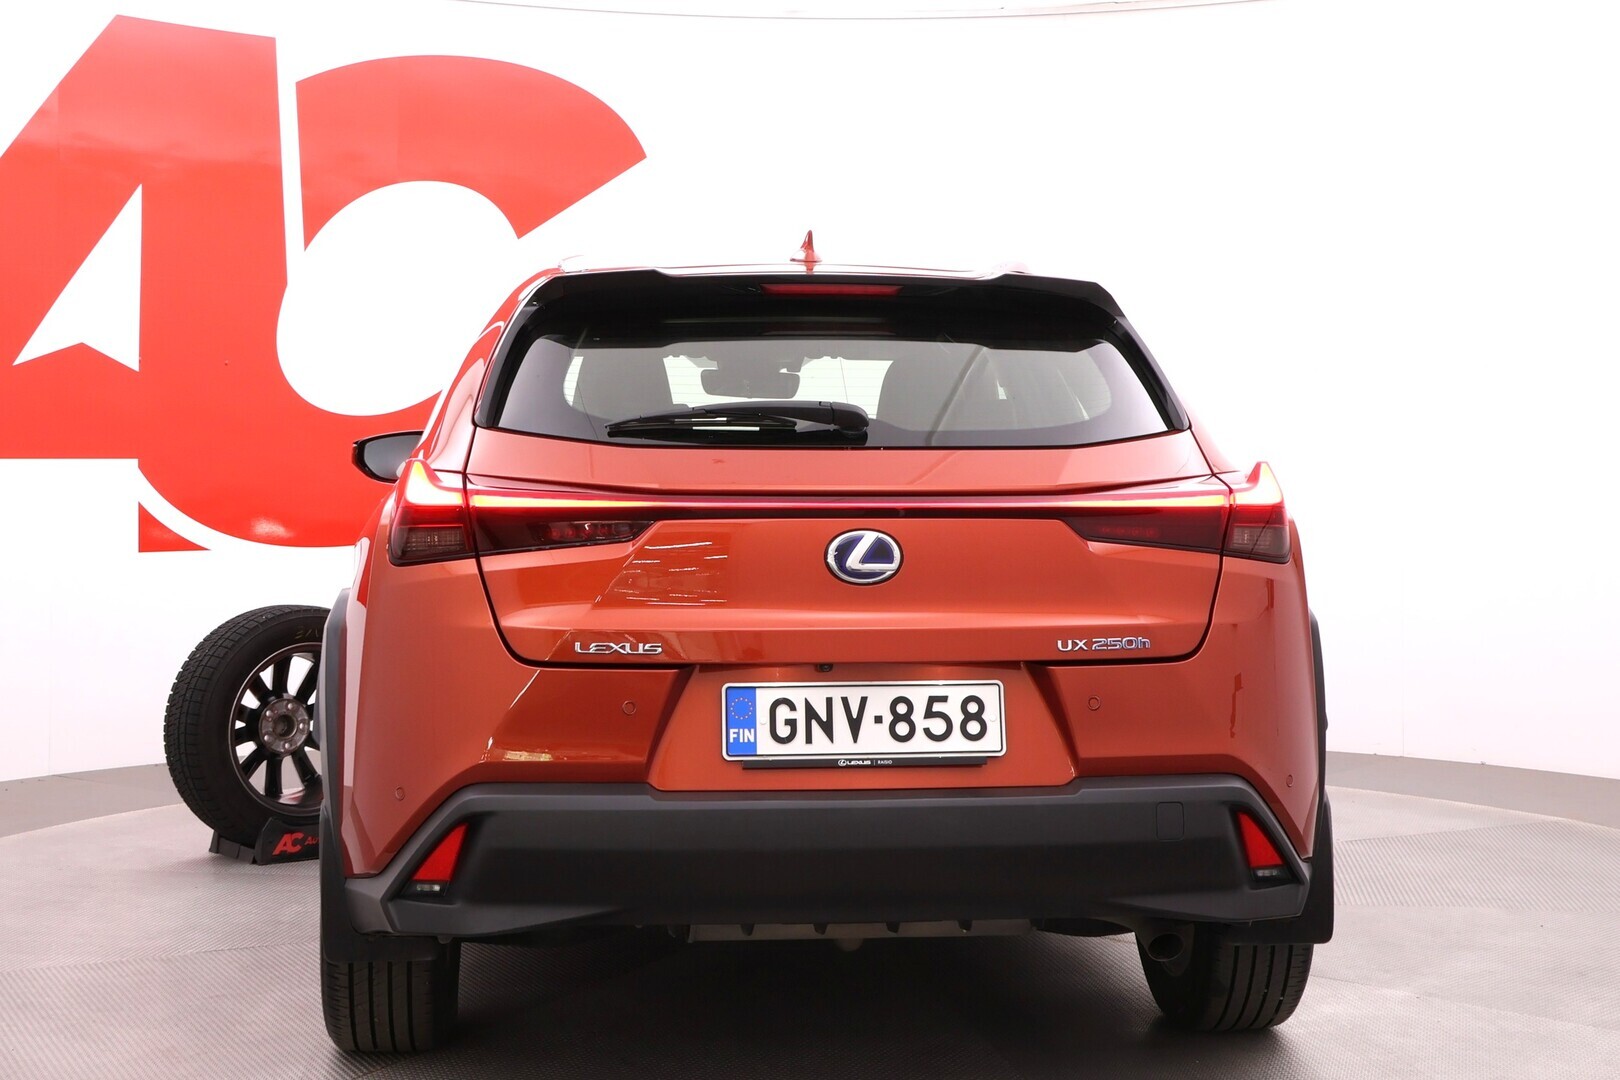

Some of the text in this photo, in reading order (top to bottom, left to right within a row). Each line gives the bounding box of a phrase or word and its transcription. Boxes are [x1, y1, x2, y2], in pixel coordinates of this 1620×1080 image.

[0, 14, 647, 553] AC
[574, 641, 663, 655] LEXUS
[1057, 637, 1151, 651] UX 250h
[769, 695, 988, 745] GNV-858
[729, 728, 755, 743] FIN
[272, 832, 304, 855] AC
